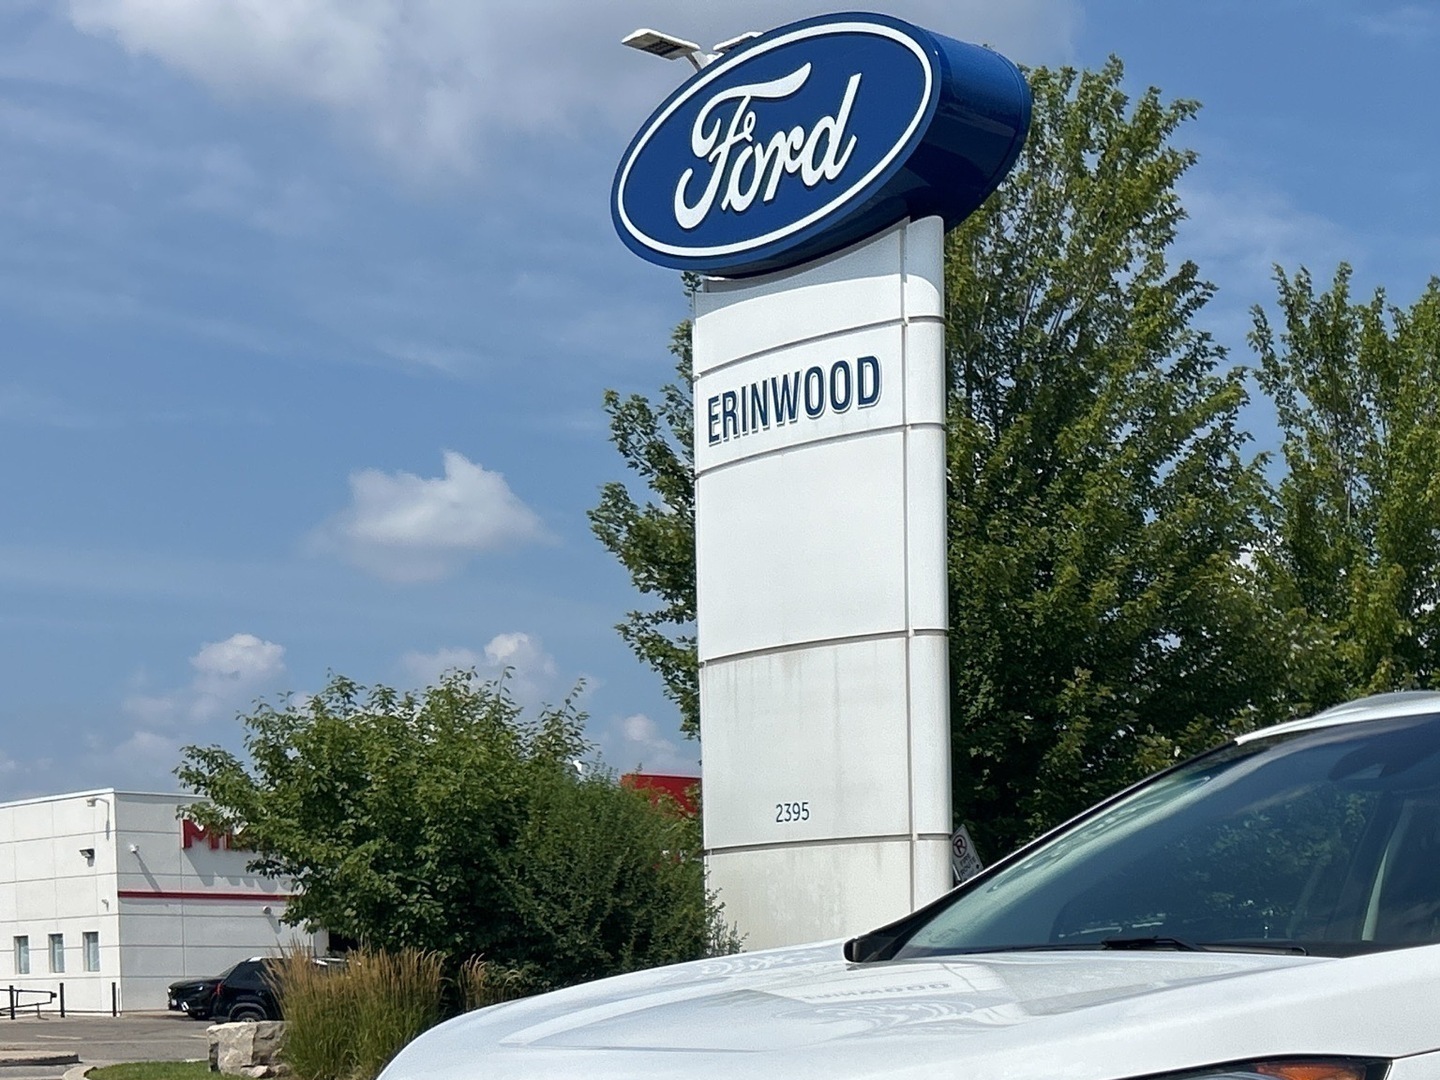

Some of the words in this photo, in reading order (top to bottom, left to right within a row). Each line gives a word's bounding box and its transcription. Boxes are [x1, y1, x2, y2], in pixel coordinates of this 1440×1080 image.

[674, 62, 862, 229] Ford
[707, 354, 884, 447] ERINWOOD
[775, 802, 810, 823] 2395
